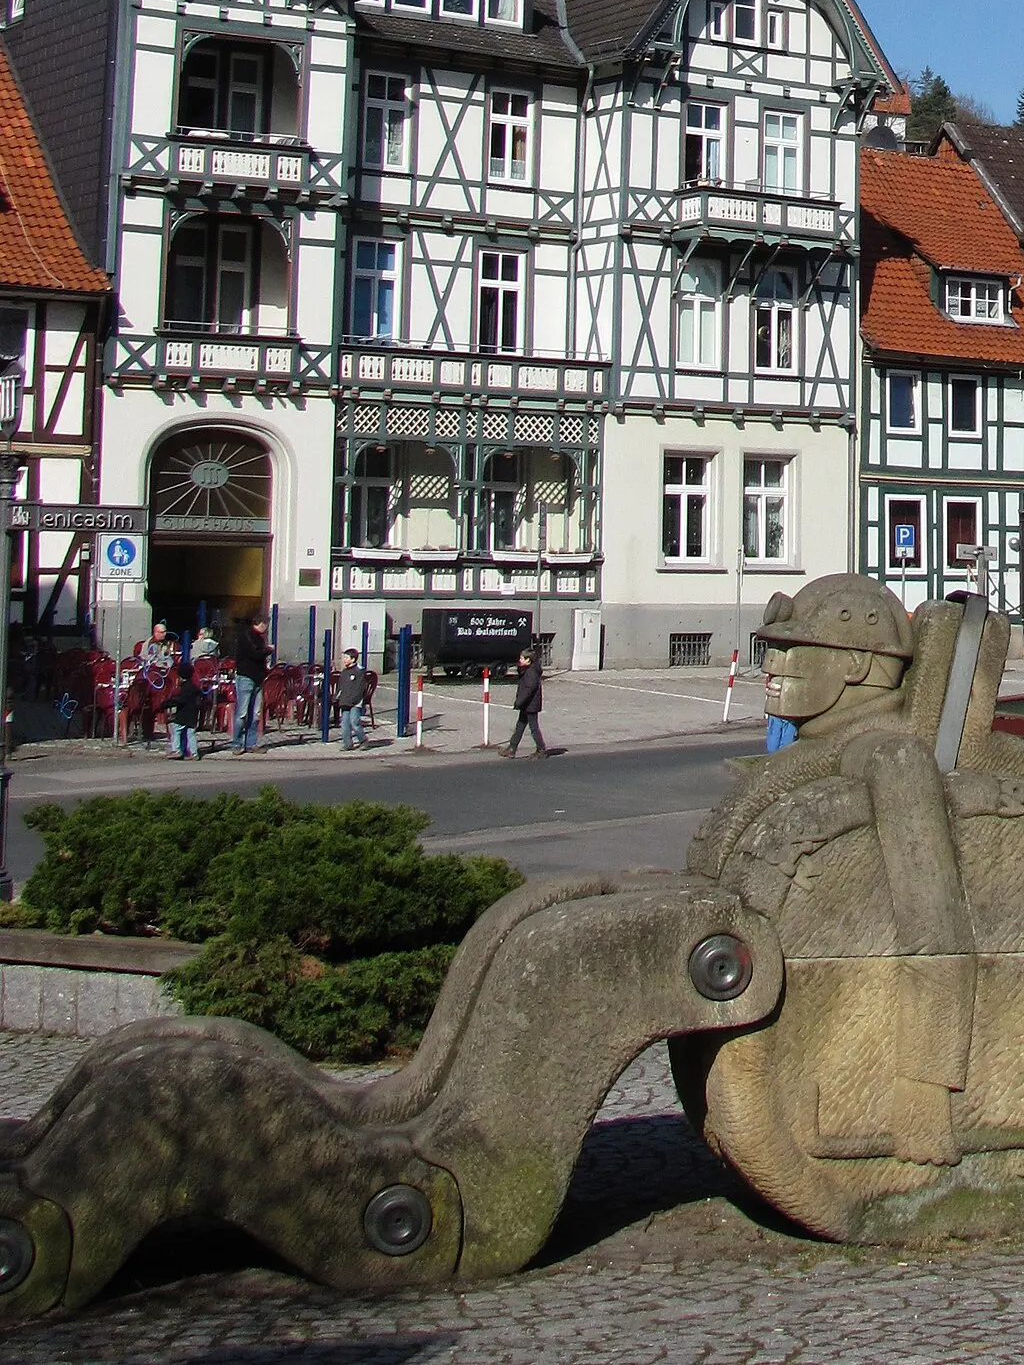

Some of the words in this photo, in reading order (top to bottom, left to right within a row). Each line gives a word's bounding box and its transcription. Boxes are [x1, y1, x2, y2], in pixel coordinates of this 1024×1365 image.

[40, 509, 134, 529] enicasim
[900, 528, 910, 544] P
[110, 568, 132, 576] ZONE
